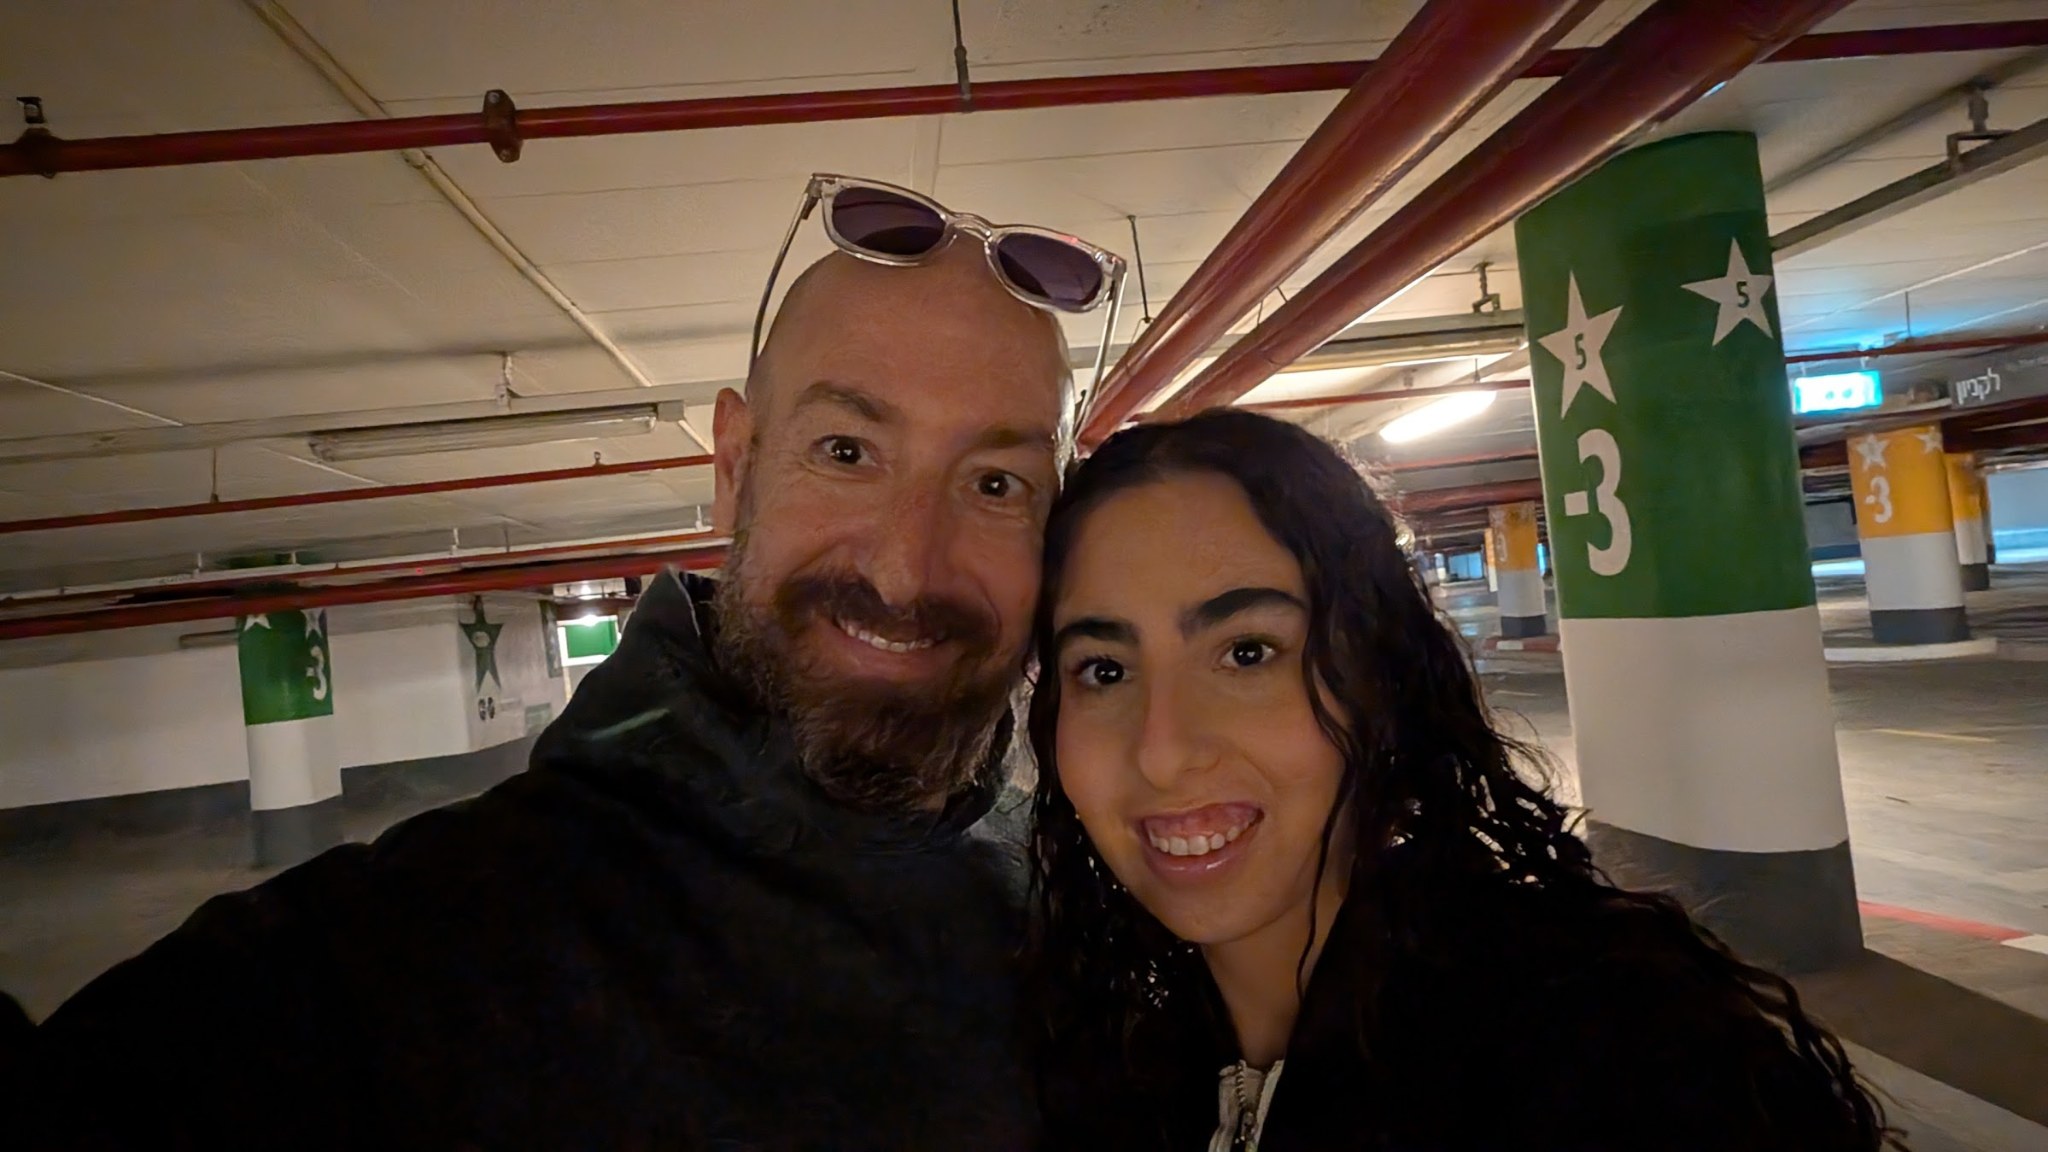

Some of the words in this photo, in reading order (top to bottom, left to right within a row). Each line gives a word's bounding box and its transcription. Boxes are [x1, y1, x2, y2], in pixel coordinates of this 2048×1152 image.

[1736, 281, 1749, 308] 5
[1574, 333, 1587, 370] 5
[1564, 428, 1632, 576] -3
[1865, 476, 1892, 524] -3
